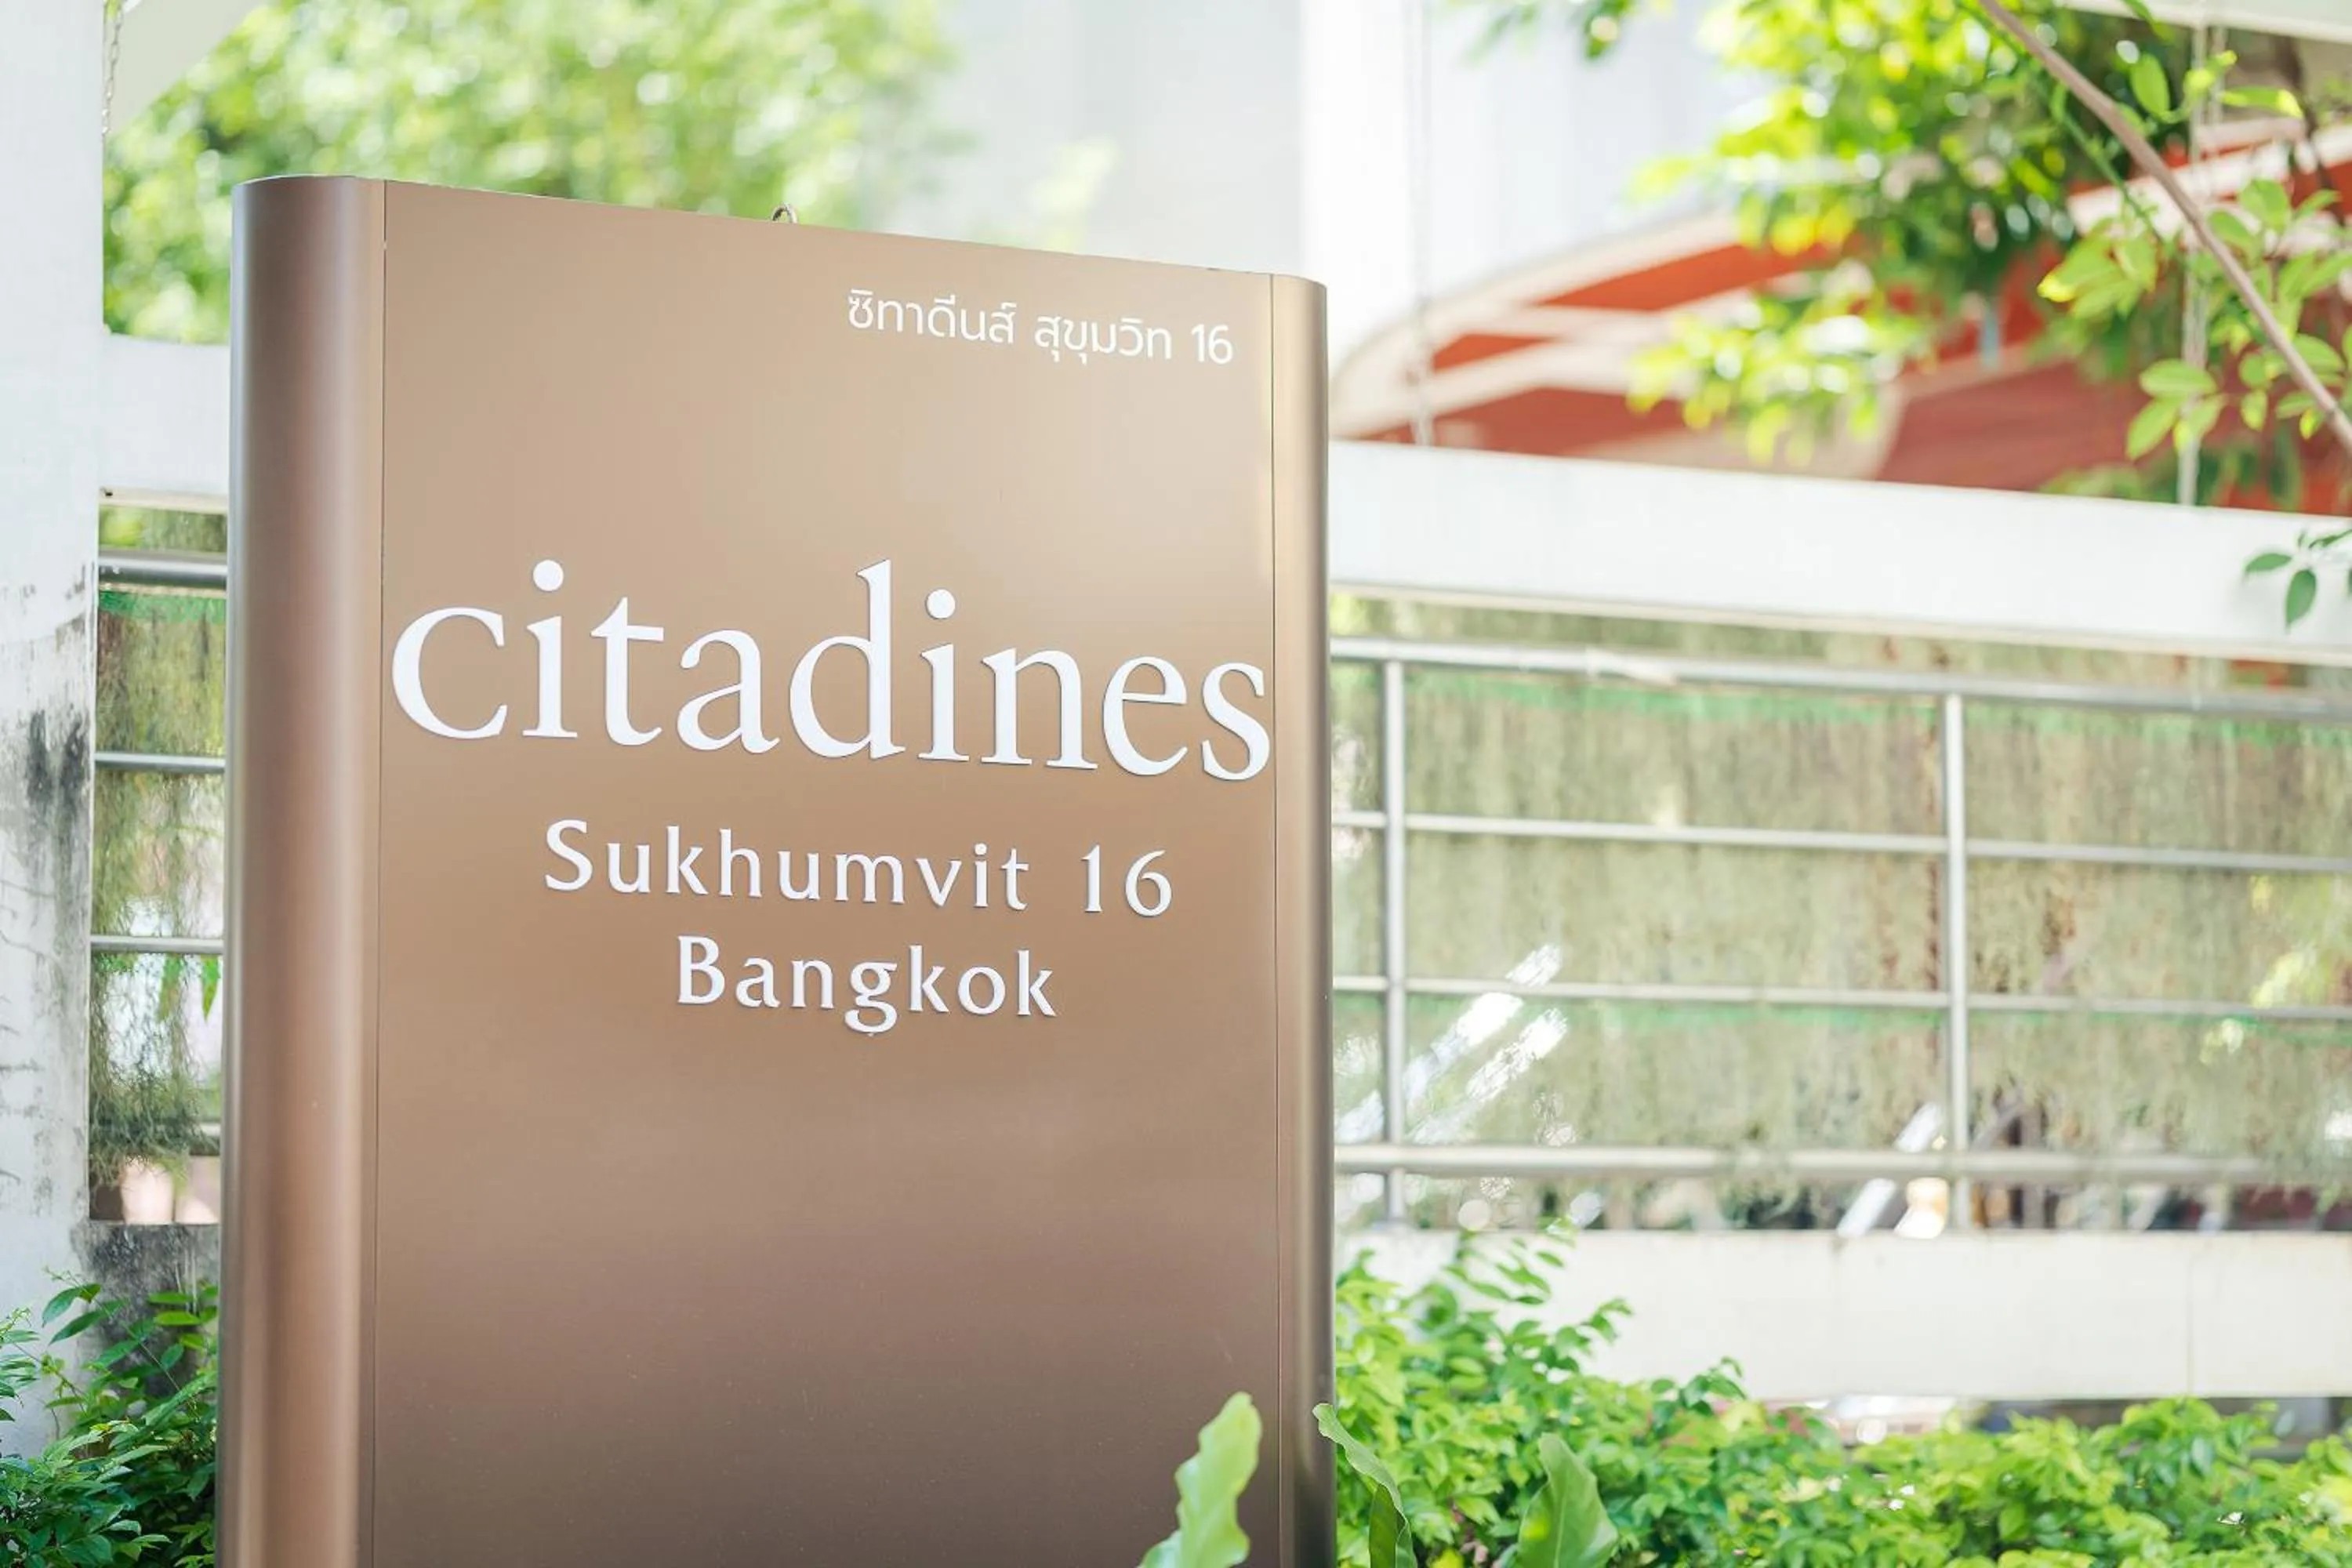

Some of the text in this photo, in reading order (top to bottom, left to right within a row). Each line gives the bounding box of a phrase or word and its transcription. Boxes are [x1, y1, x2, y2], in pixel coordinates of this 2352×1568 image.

[848, 288, 1234, 365] ซิทาดีนส์ สุขุมวิท 16
[391, 558, 1272, 782] citadines
[544, 818, 1173, 916] Sukhumvit 16
[677, 935, 1058, 1034] Bangkok
